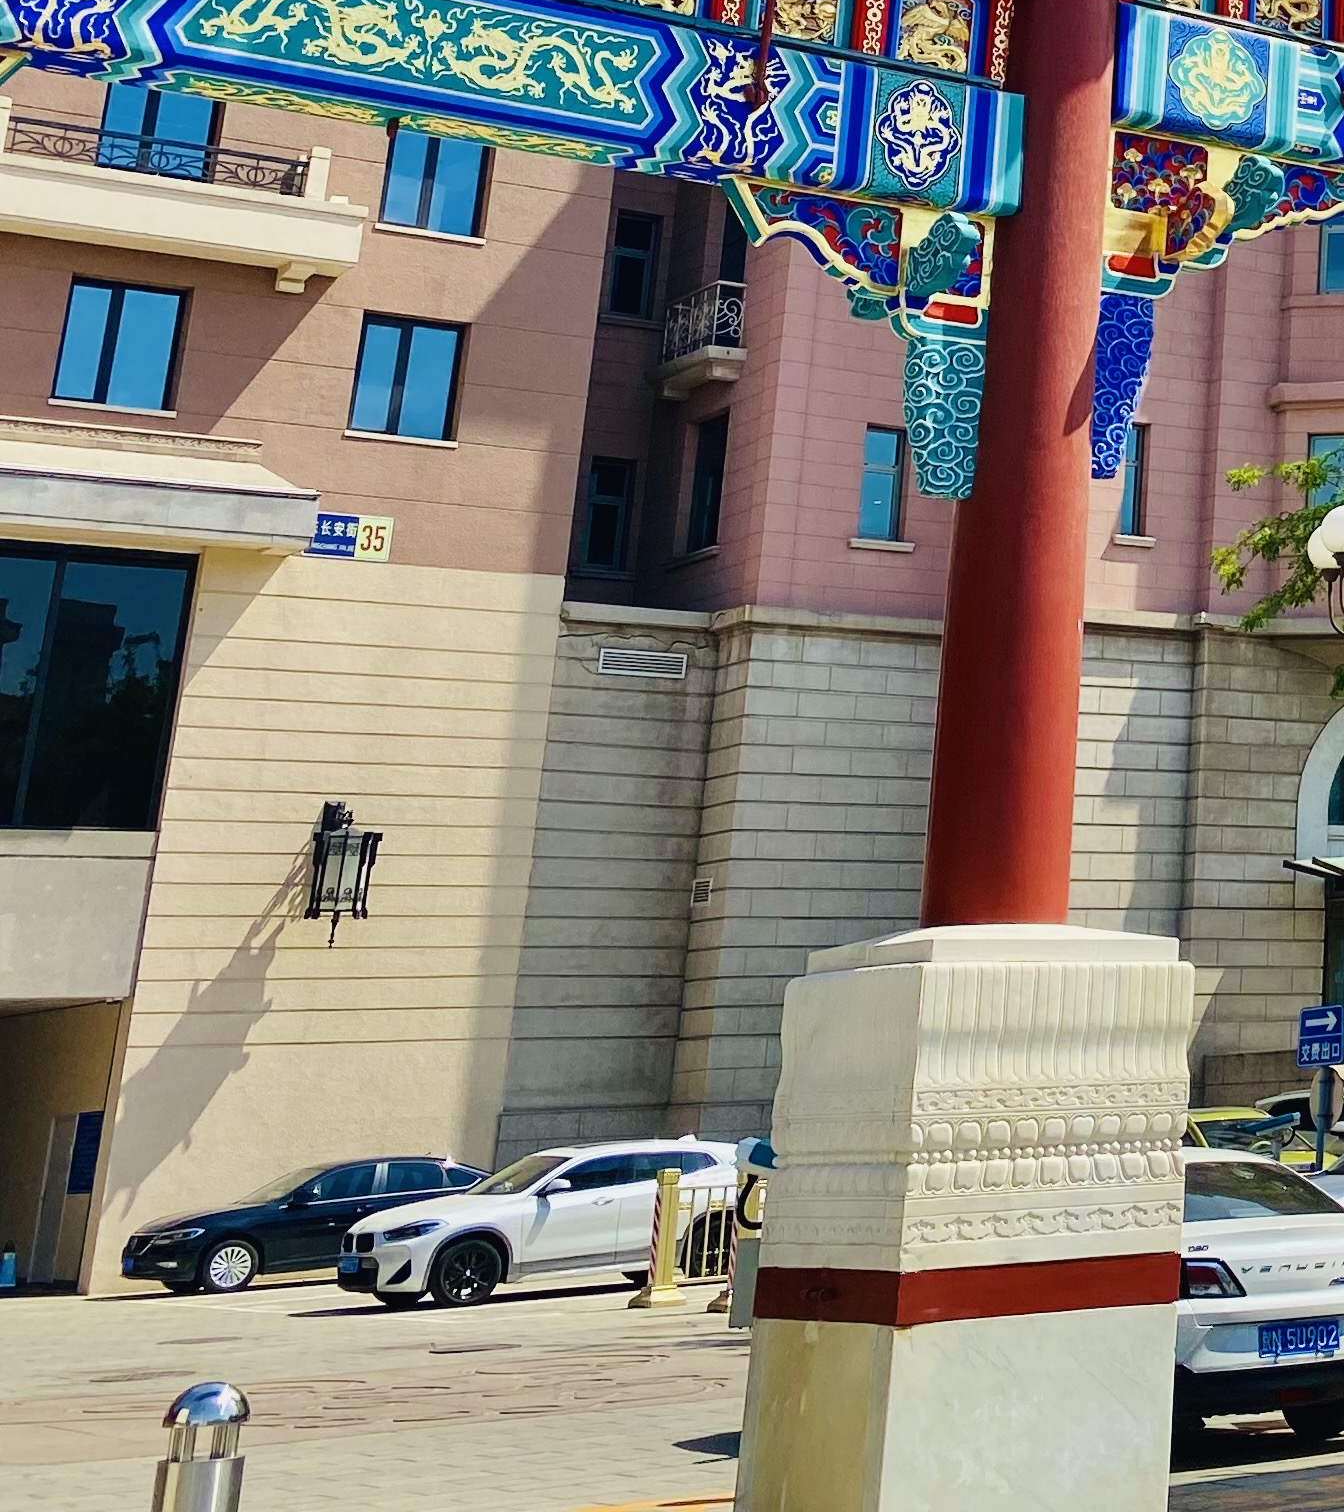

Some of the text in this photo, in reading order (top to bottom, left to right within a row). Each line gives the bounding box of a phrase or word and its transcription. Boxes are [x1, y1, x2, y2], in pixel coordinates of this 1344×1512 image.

[360, 524, 387, 552] 35
[1301, 1041, 1340, 1062] 交费出口
